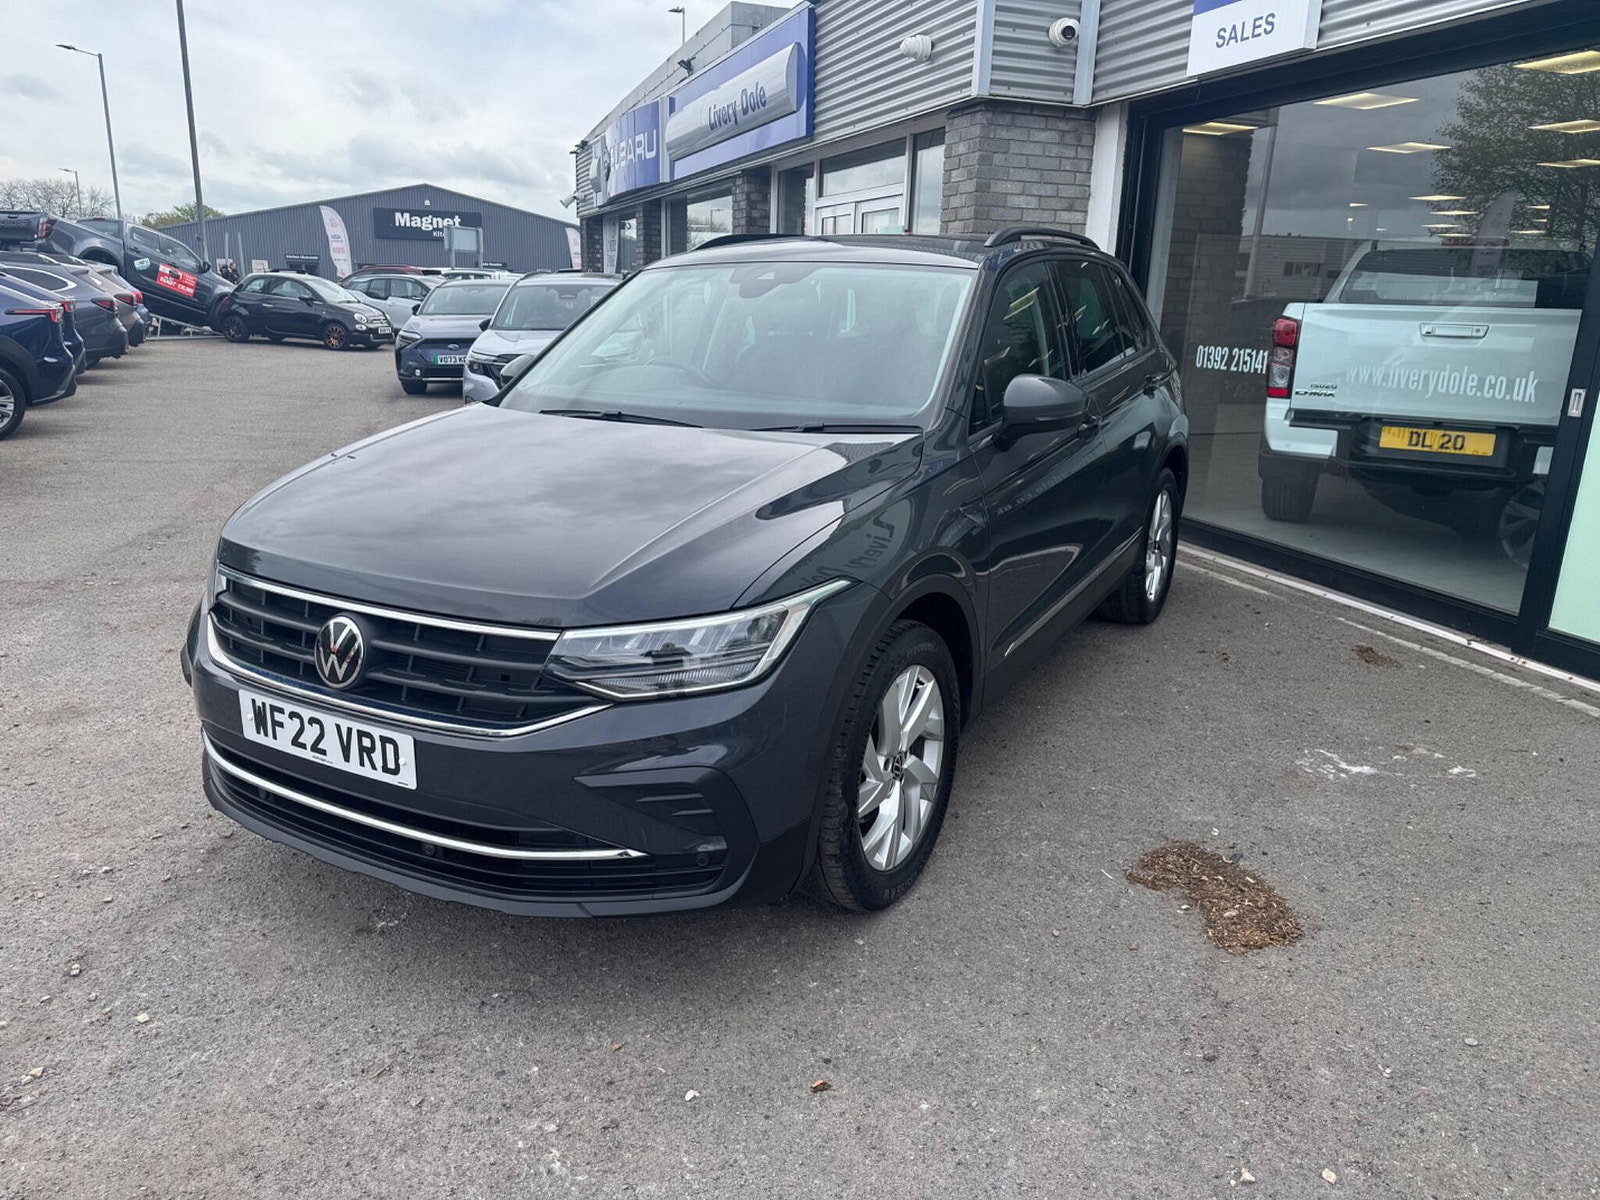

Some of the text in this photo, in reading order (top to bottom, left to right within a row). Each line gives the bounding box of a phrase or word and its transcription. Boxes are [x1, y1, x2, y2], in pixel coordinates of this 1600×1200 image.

[1215, 12, 1276, 49] SALES
[708, 81, 767, 131] Livery Dole
[394, 211, 462, 231] Magnet
[1195, 344, 1269, 375] 01392 215141
[1345, 363, 1540, 403] www.liverydole.co.uk
[1407, 430, 1467, 451] DL 20
[250, 697, 402, 777] WF22 VRD
